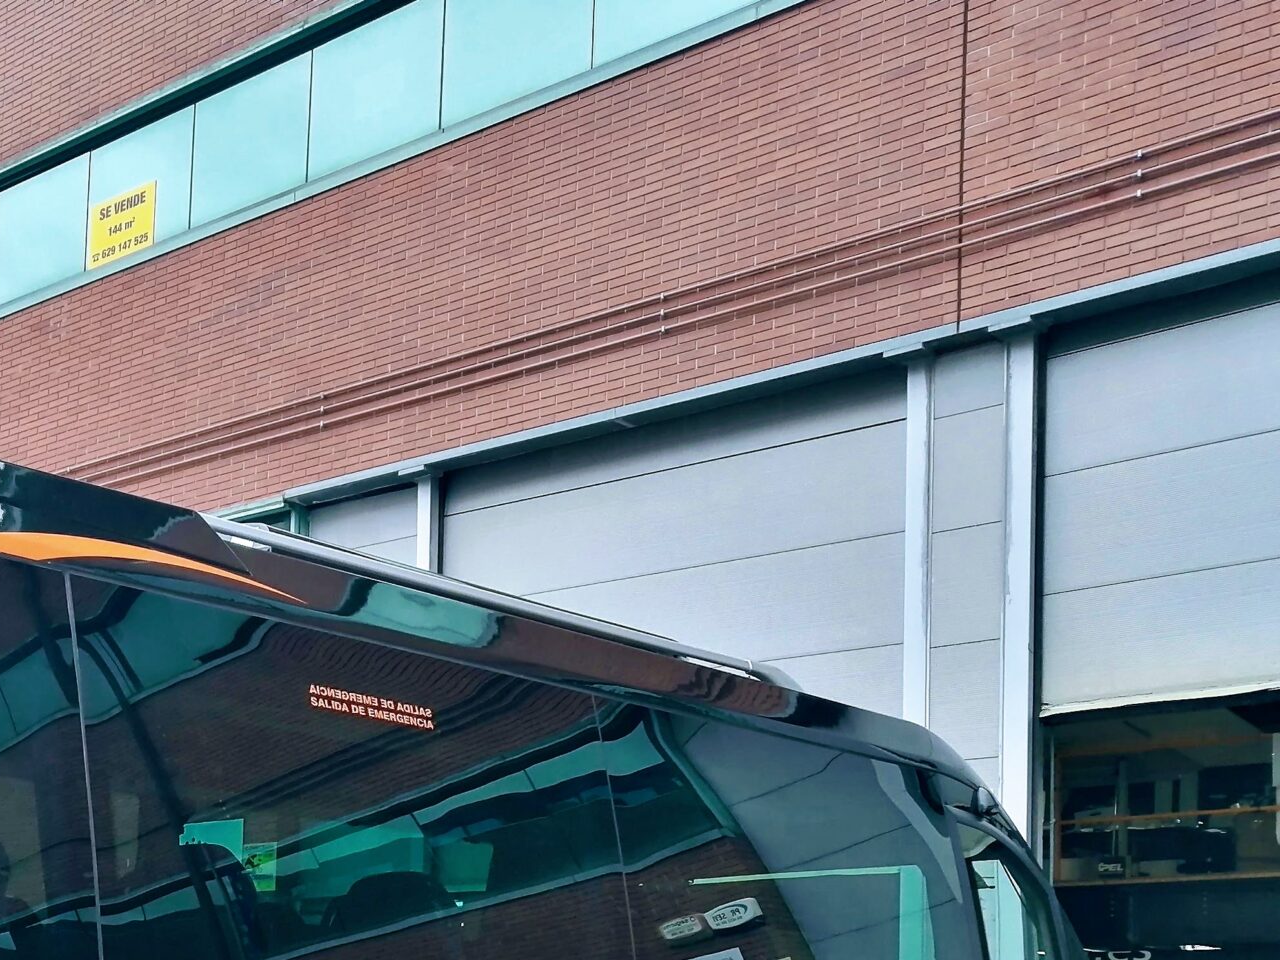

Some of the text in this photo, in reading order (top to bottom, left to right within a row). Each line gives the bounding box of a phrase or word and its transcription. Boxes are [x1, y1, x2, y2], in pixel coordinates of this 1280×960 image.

[99, 190, 147, 221] SE VENDE
[108, 222, 123, 237] 144
[101, 232, 149, 259] 629 147 525
[310, 696, 435, 730] SALIDA DE EMERGENCIA
